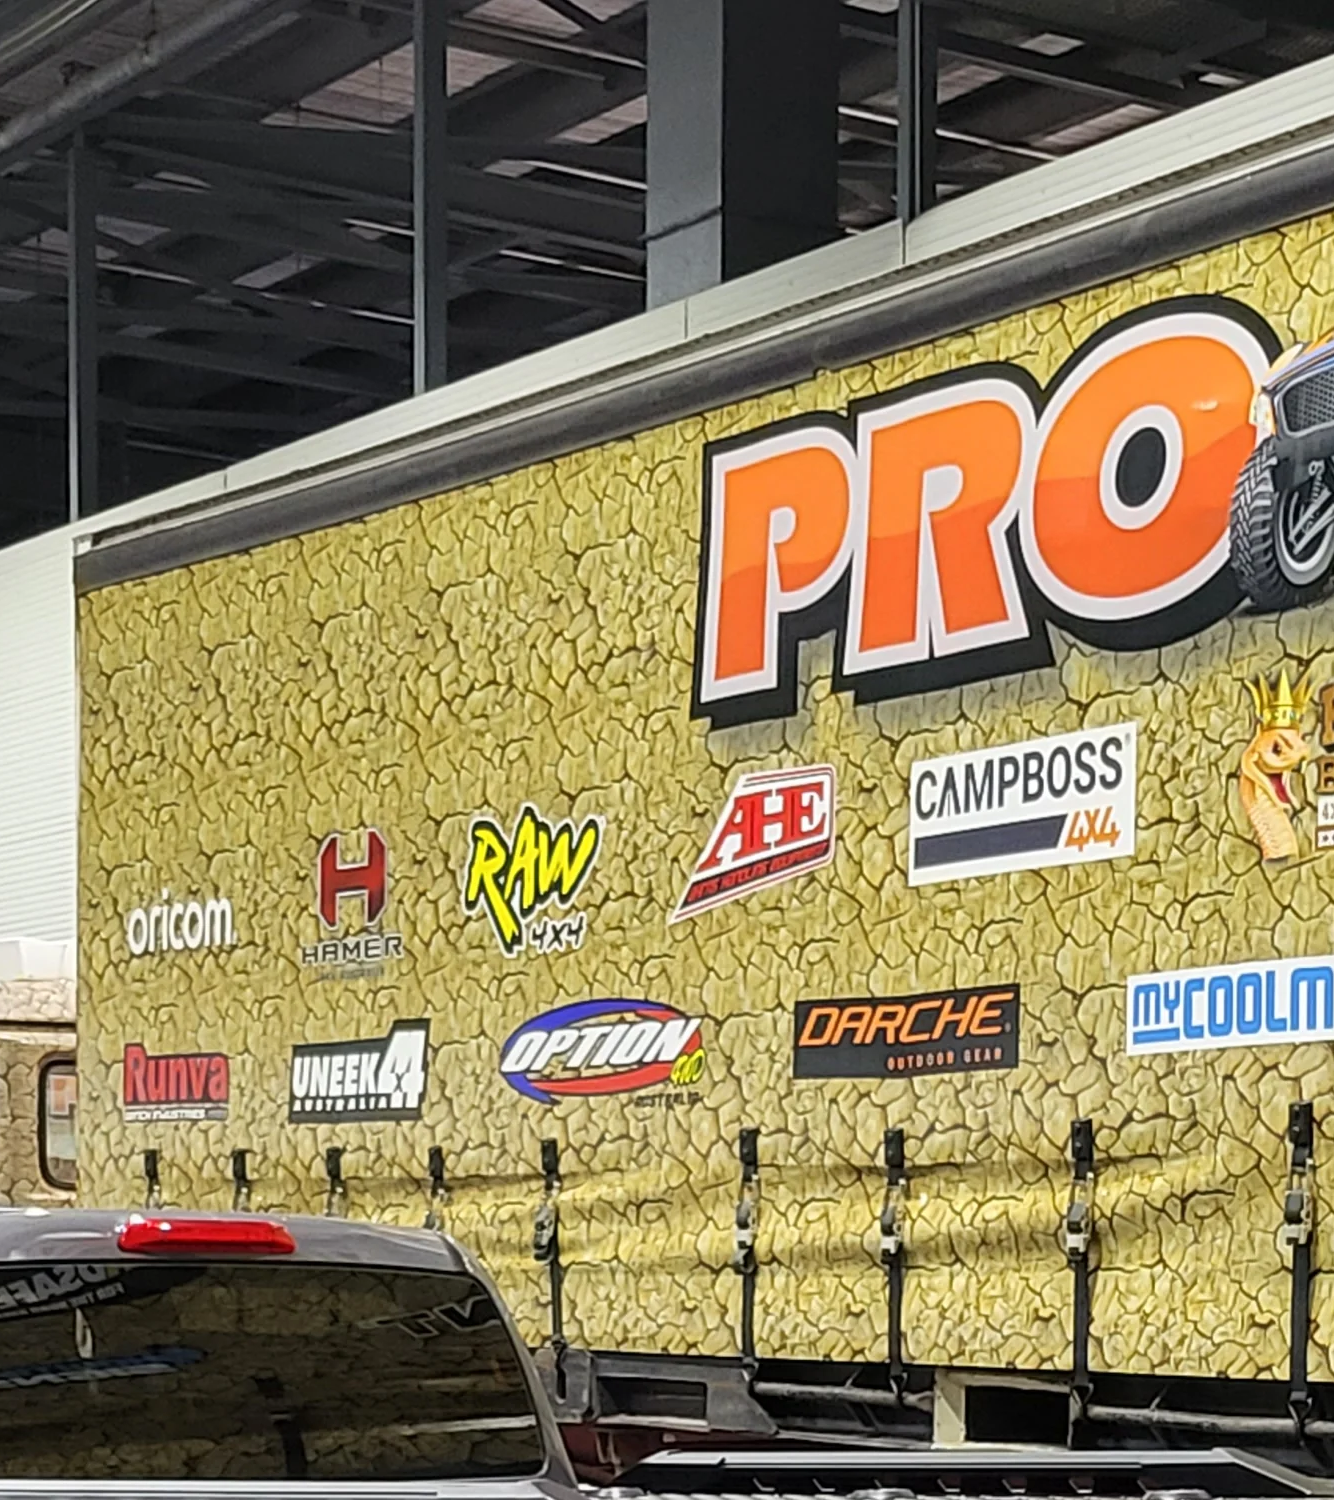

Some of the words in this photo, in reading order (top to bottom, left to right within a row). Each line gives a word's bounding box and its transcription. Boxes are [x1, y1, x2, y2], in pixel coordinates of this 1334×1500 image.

[701, 312, 1267, 702] PRO
[915, 736, 1123, 820] CAMPBOSS
[466, 808, 598, 952] RAW
[127, 887, 233, 956] oricom
[301, 935, 404, 965] HAMER
[500, 1017, 702, 1073] OPTION
[798, 992, 1015, 1046] DARCHE
[125, 1045, 228, 1103] Runva
[292, 1053, 381, 1098] UNEEK
[887, 1050, 954, 1071] OUTDOOR
[963, 1048, 1002, 1063] GEAR
[292, 1096, 388, 1112] AUSTRALIA
